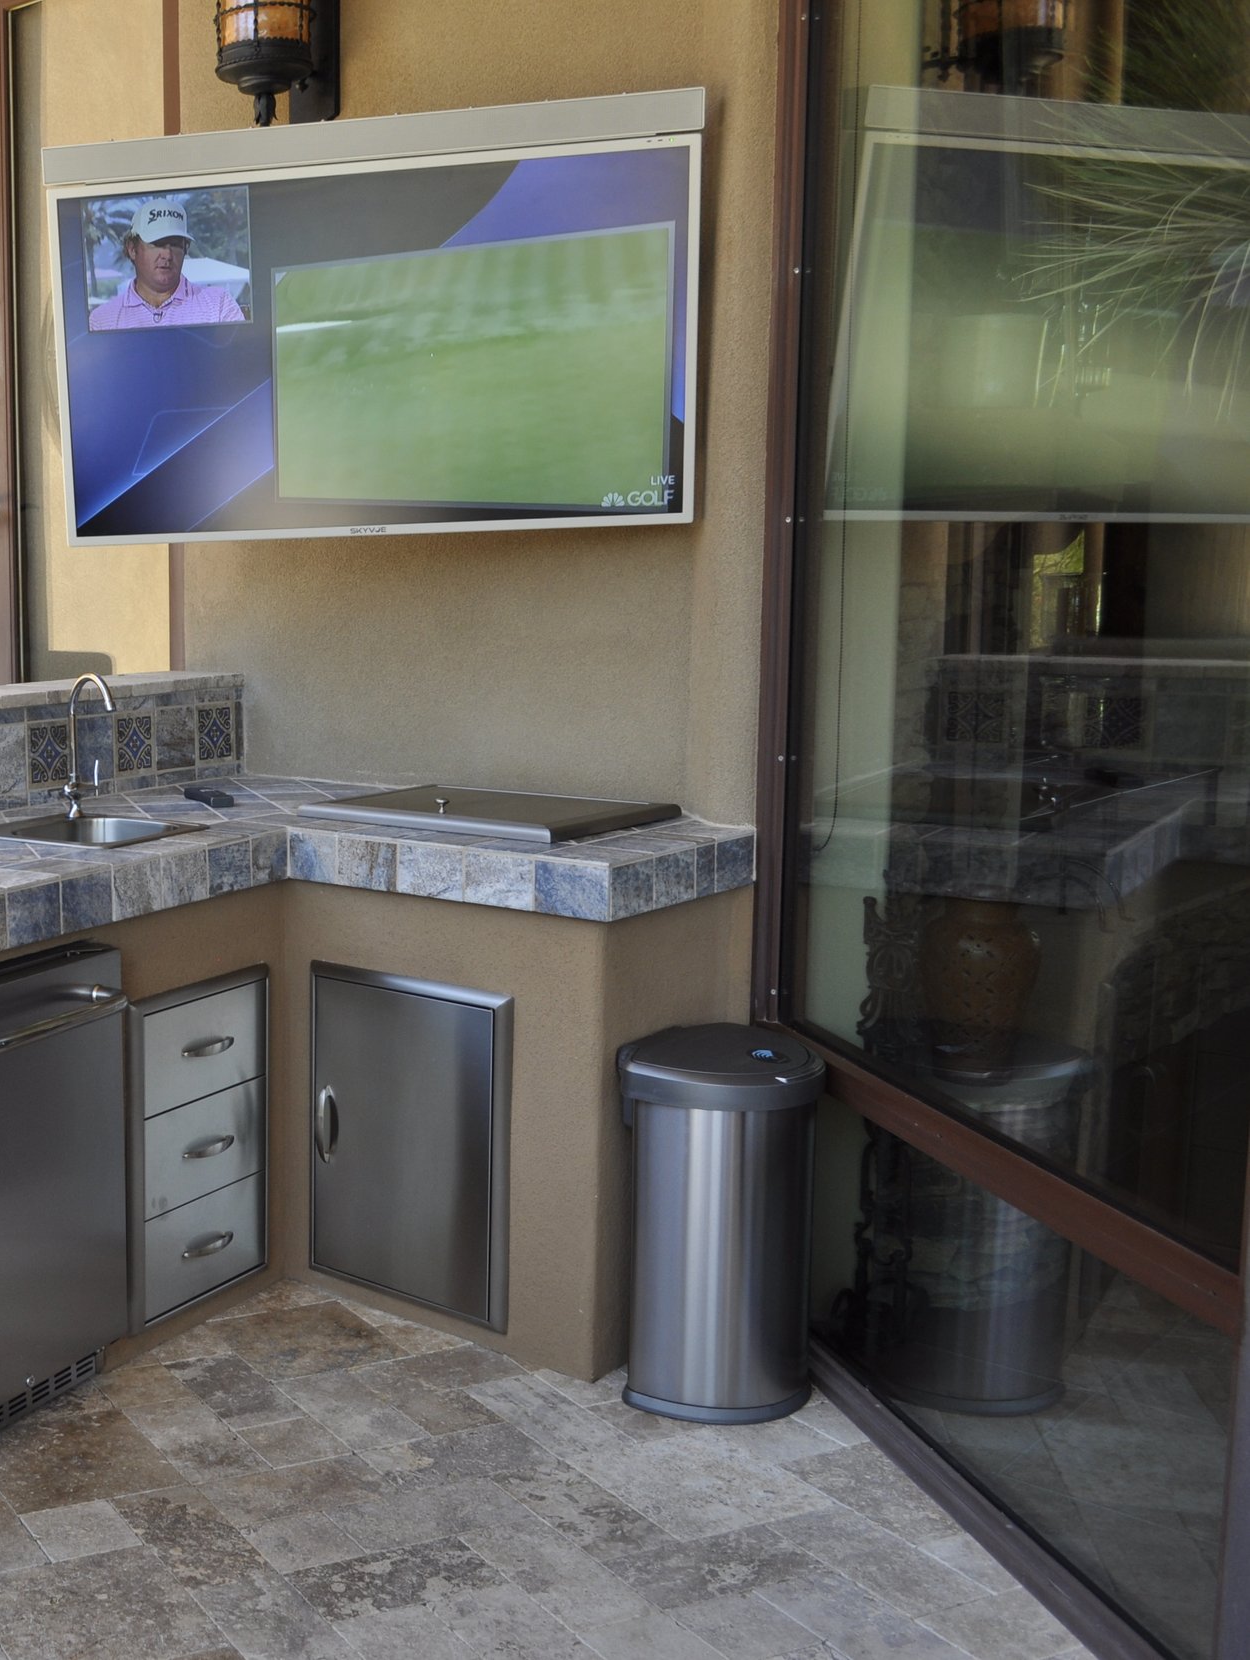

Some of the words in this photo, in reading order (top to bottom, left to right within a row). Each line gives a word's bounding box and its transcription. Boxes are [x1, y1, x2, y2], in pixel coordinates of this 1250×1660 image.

[147, 208, 184, 224] SRIXON
[650, 475, 675, 486] LIVE
[627, 490, 674, 506] GOLF
